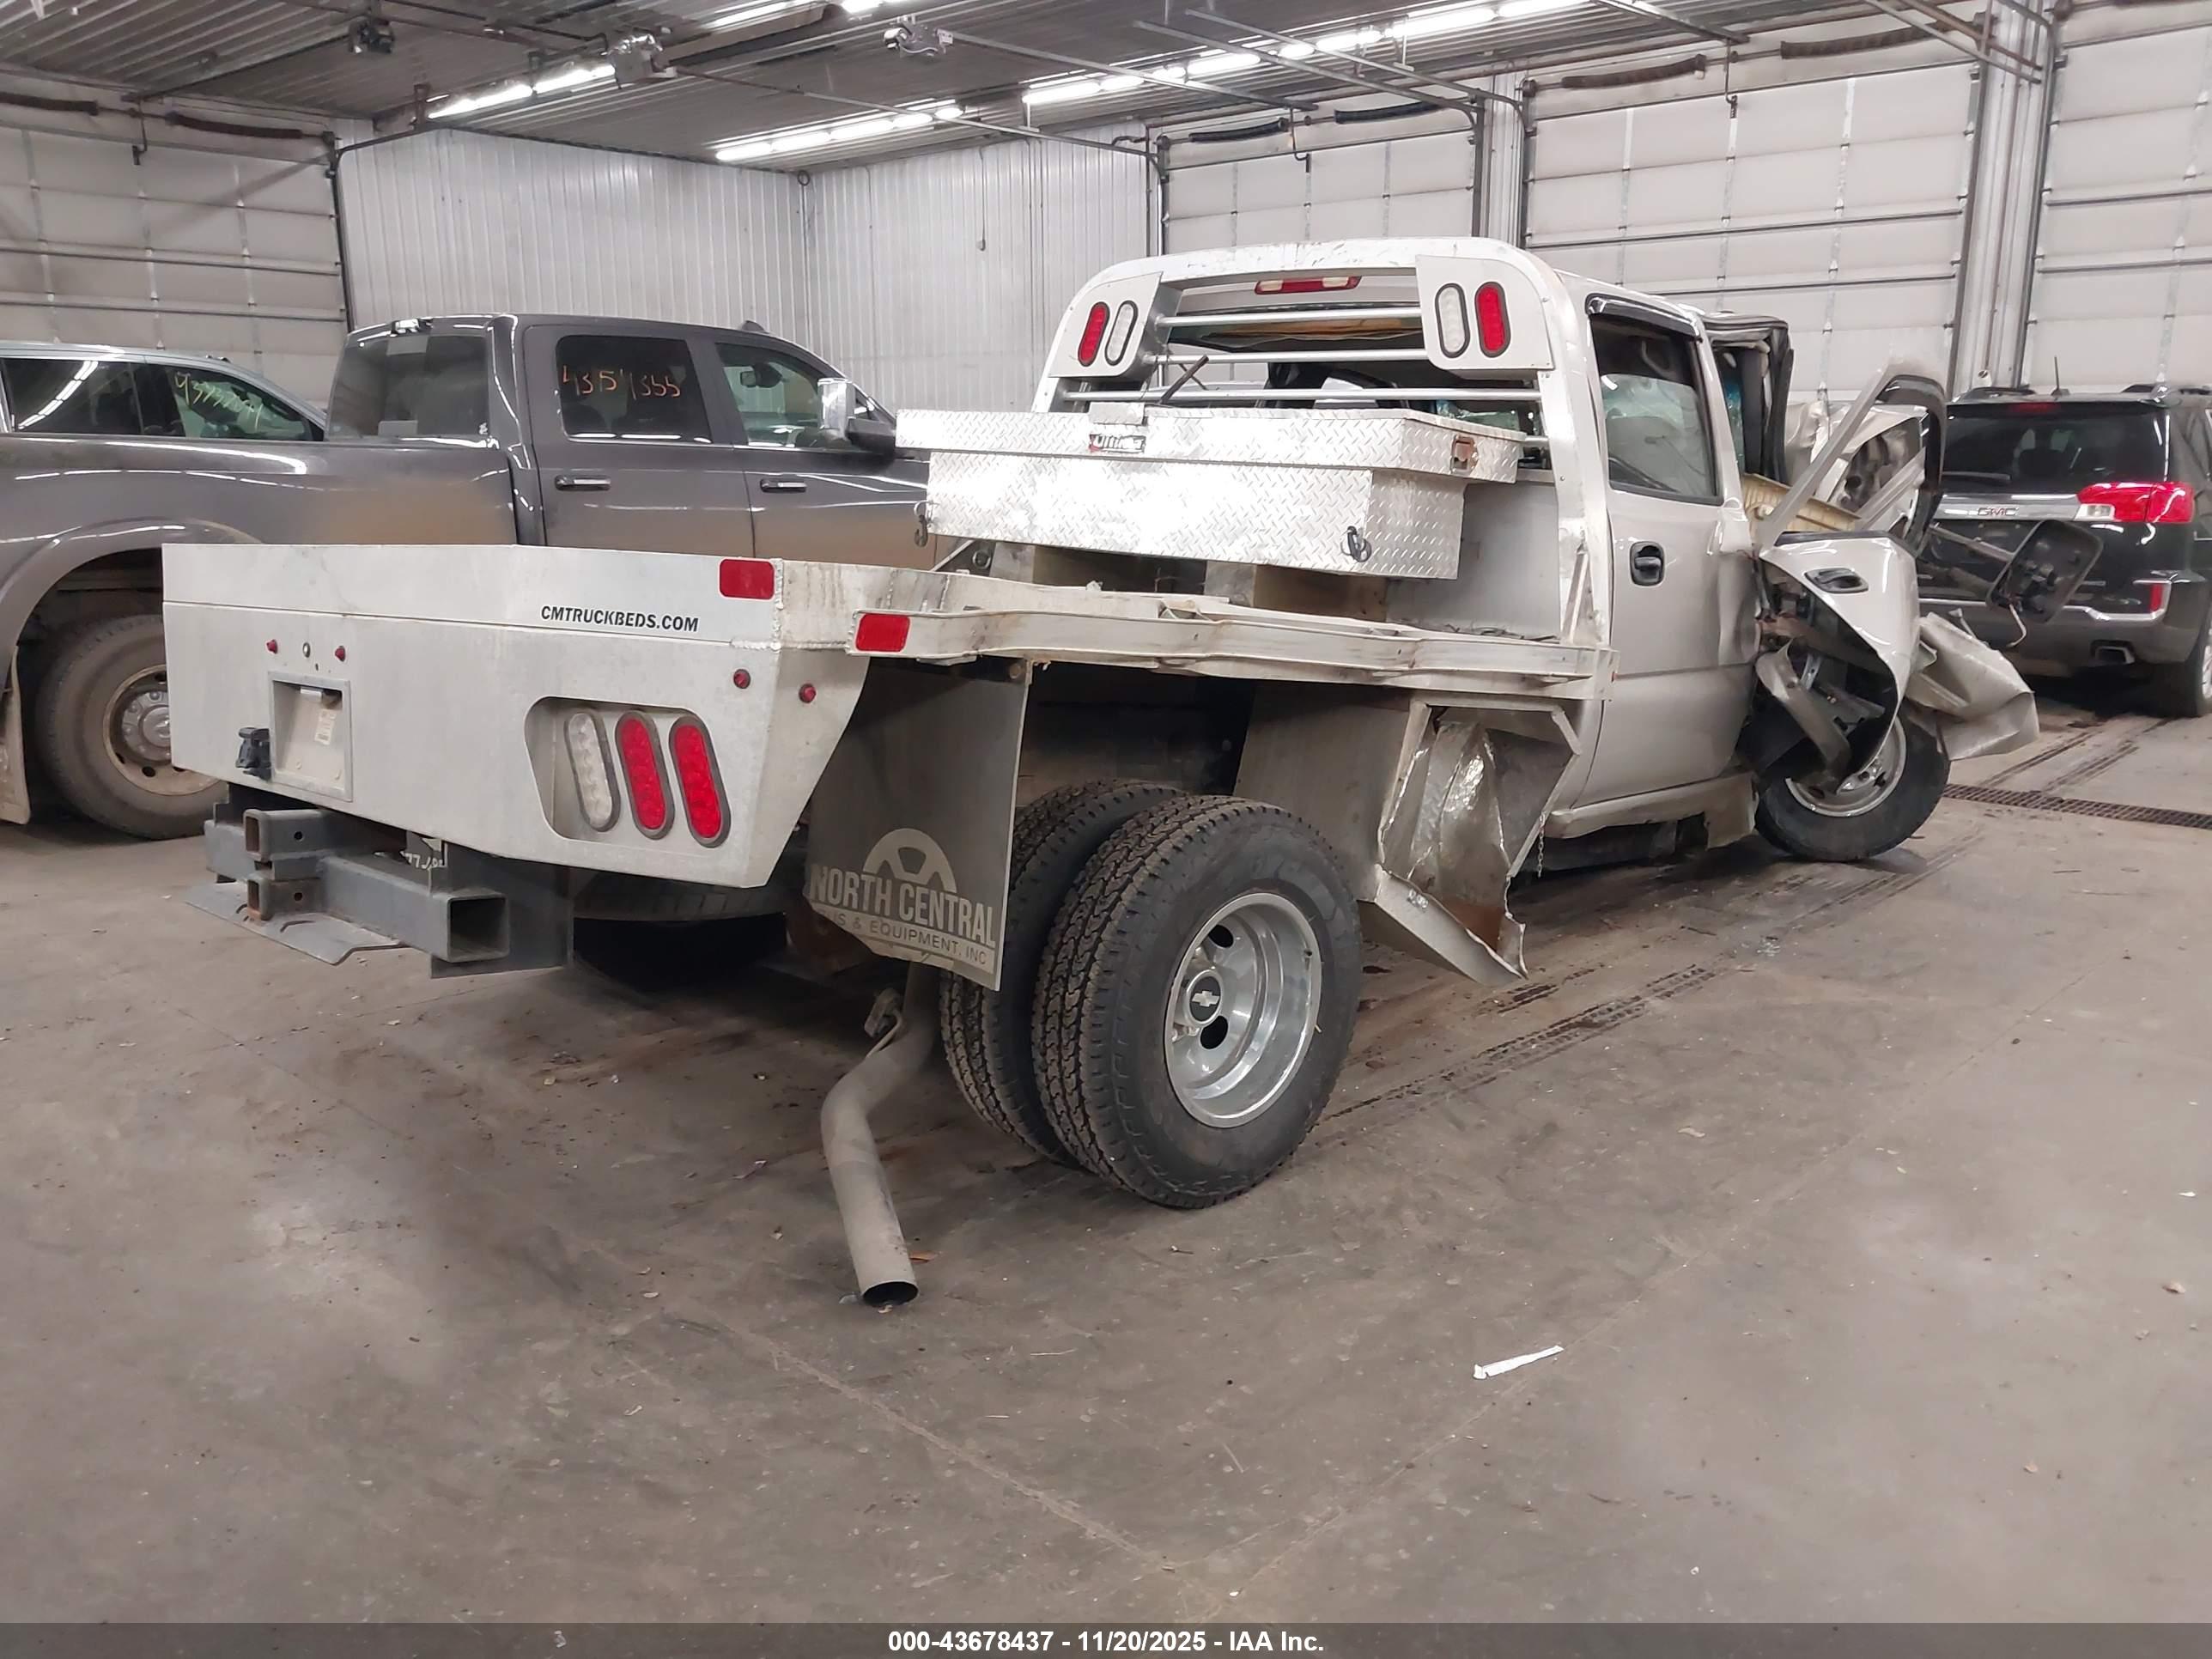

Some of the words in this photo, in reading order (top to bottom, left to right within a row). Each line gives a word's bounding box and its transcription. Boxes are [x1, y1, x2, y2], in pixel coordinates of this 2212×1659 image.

[1978, 507, 2018, 516] GMC
[540, 605, 699, 632] CMTRUCKBEDS.COM
[810, 864, 892, 917] NORTH
[899, 883, 996, 948] CENTRAL
[852, 916, 862, 931] &
